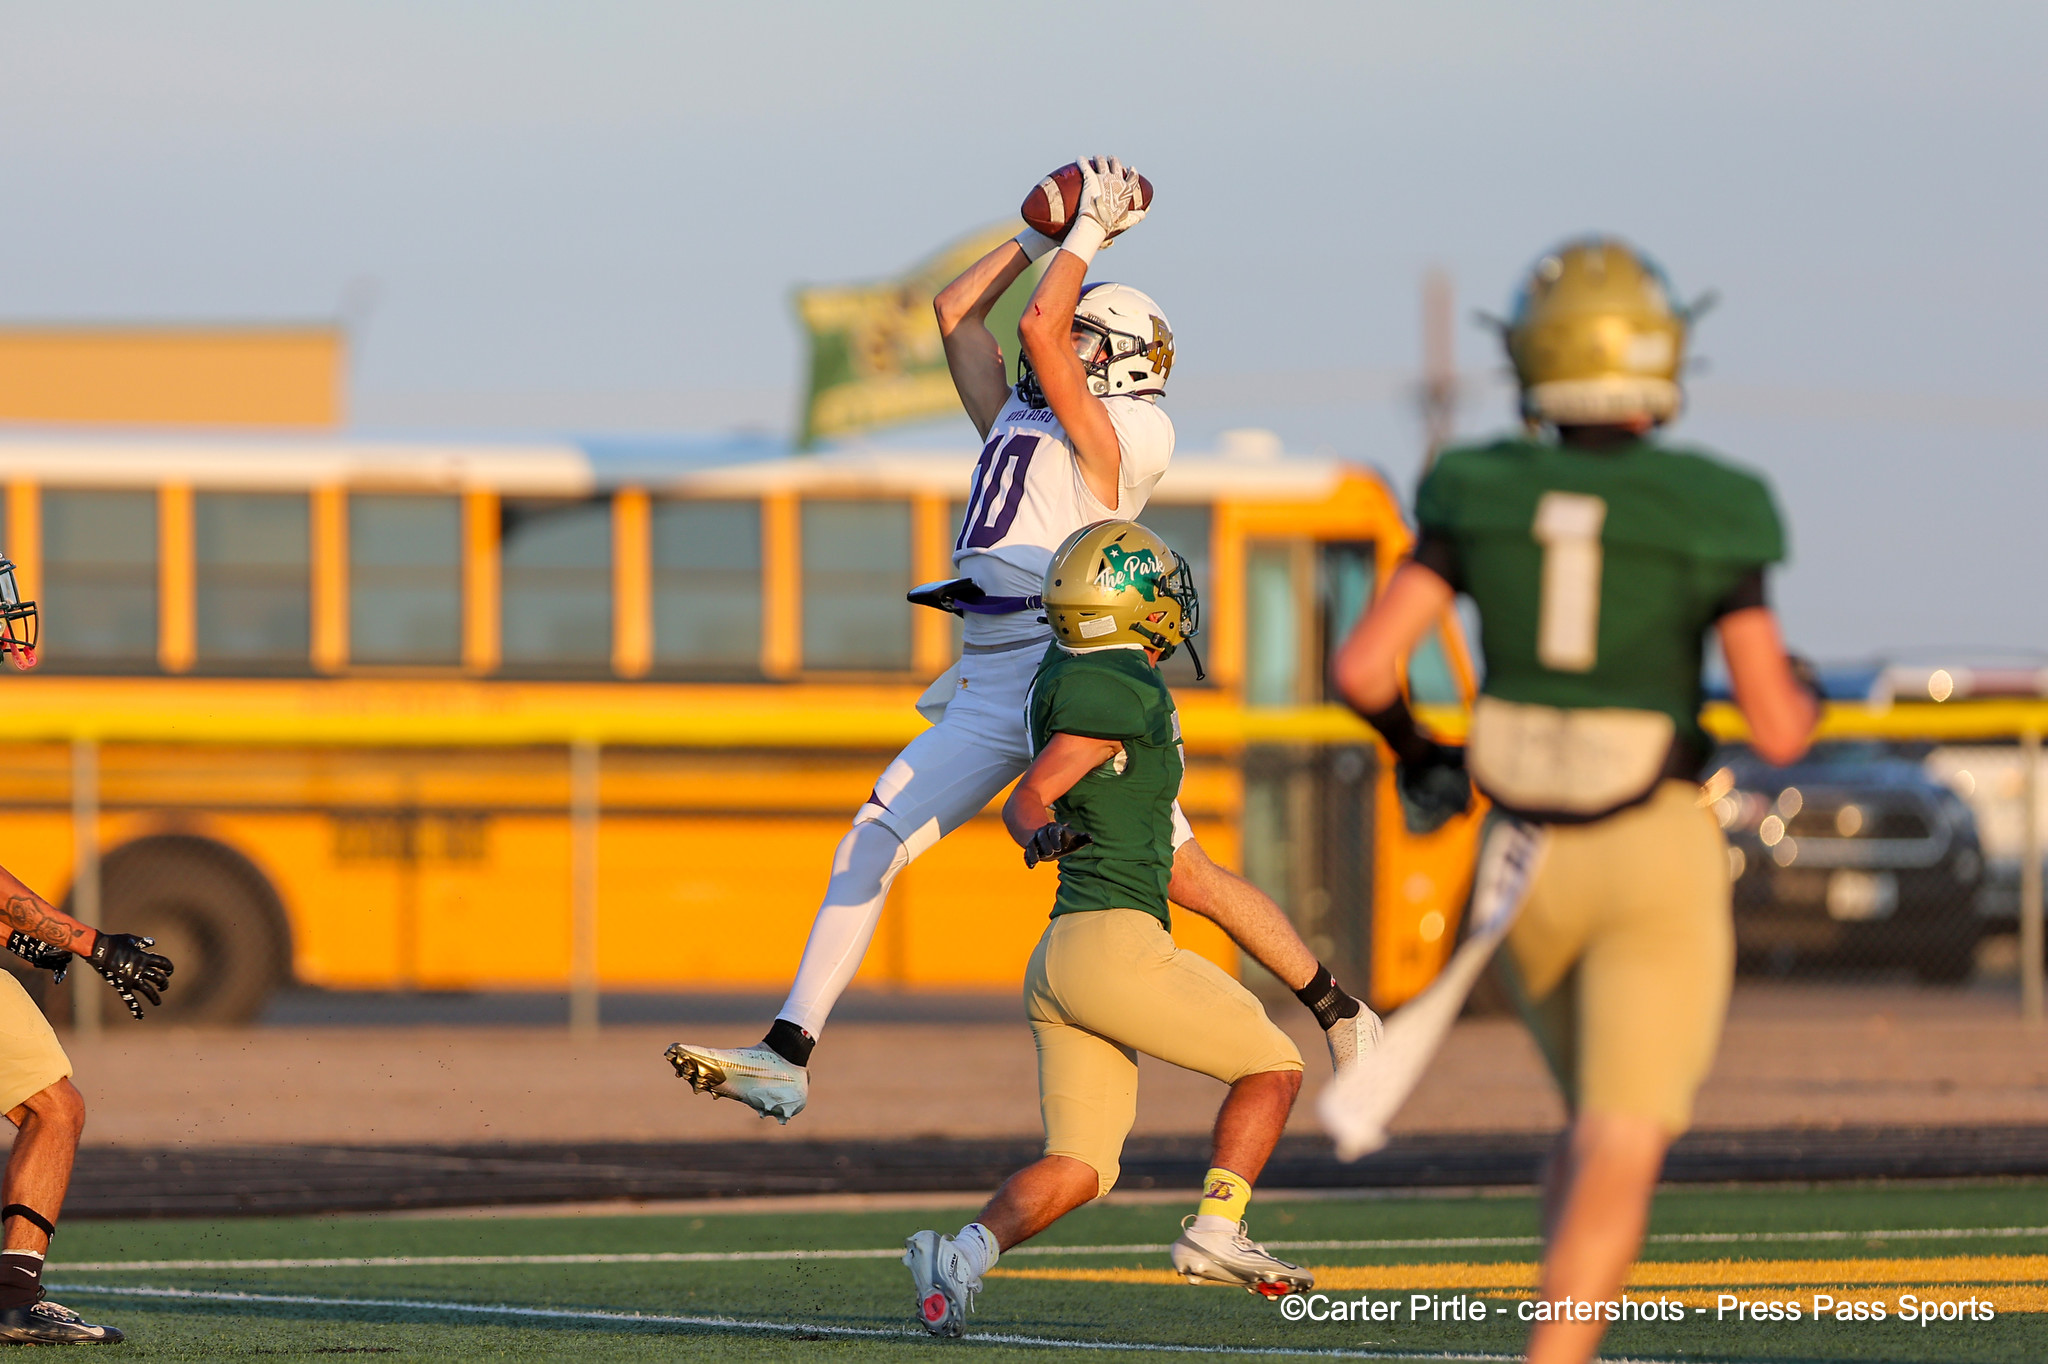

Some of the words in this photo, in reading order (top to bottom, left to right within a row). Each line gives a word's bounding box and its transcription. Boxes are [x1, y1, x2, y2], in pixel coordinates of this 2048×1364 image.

[1026, 409, 1055, 423] ROAD
[955, 434, 1041, 551] 10
[1094, 566, 1126, 589] The
[1124, 555, 1166, 581] Park
[1532, 490, 1607, 674] 1
